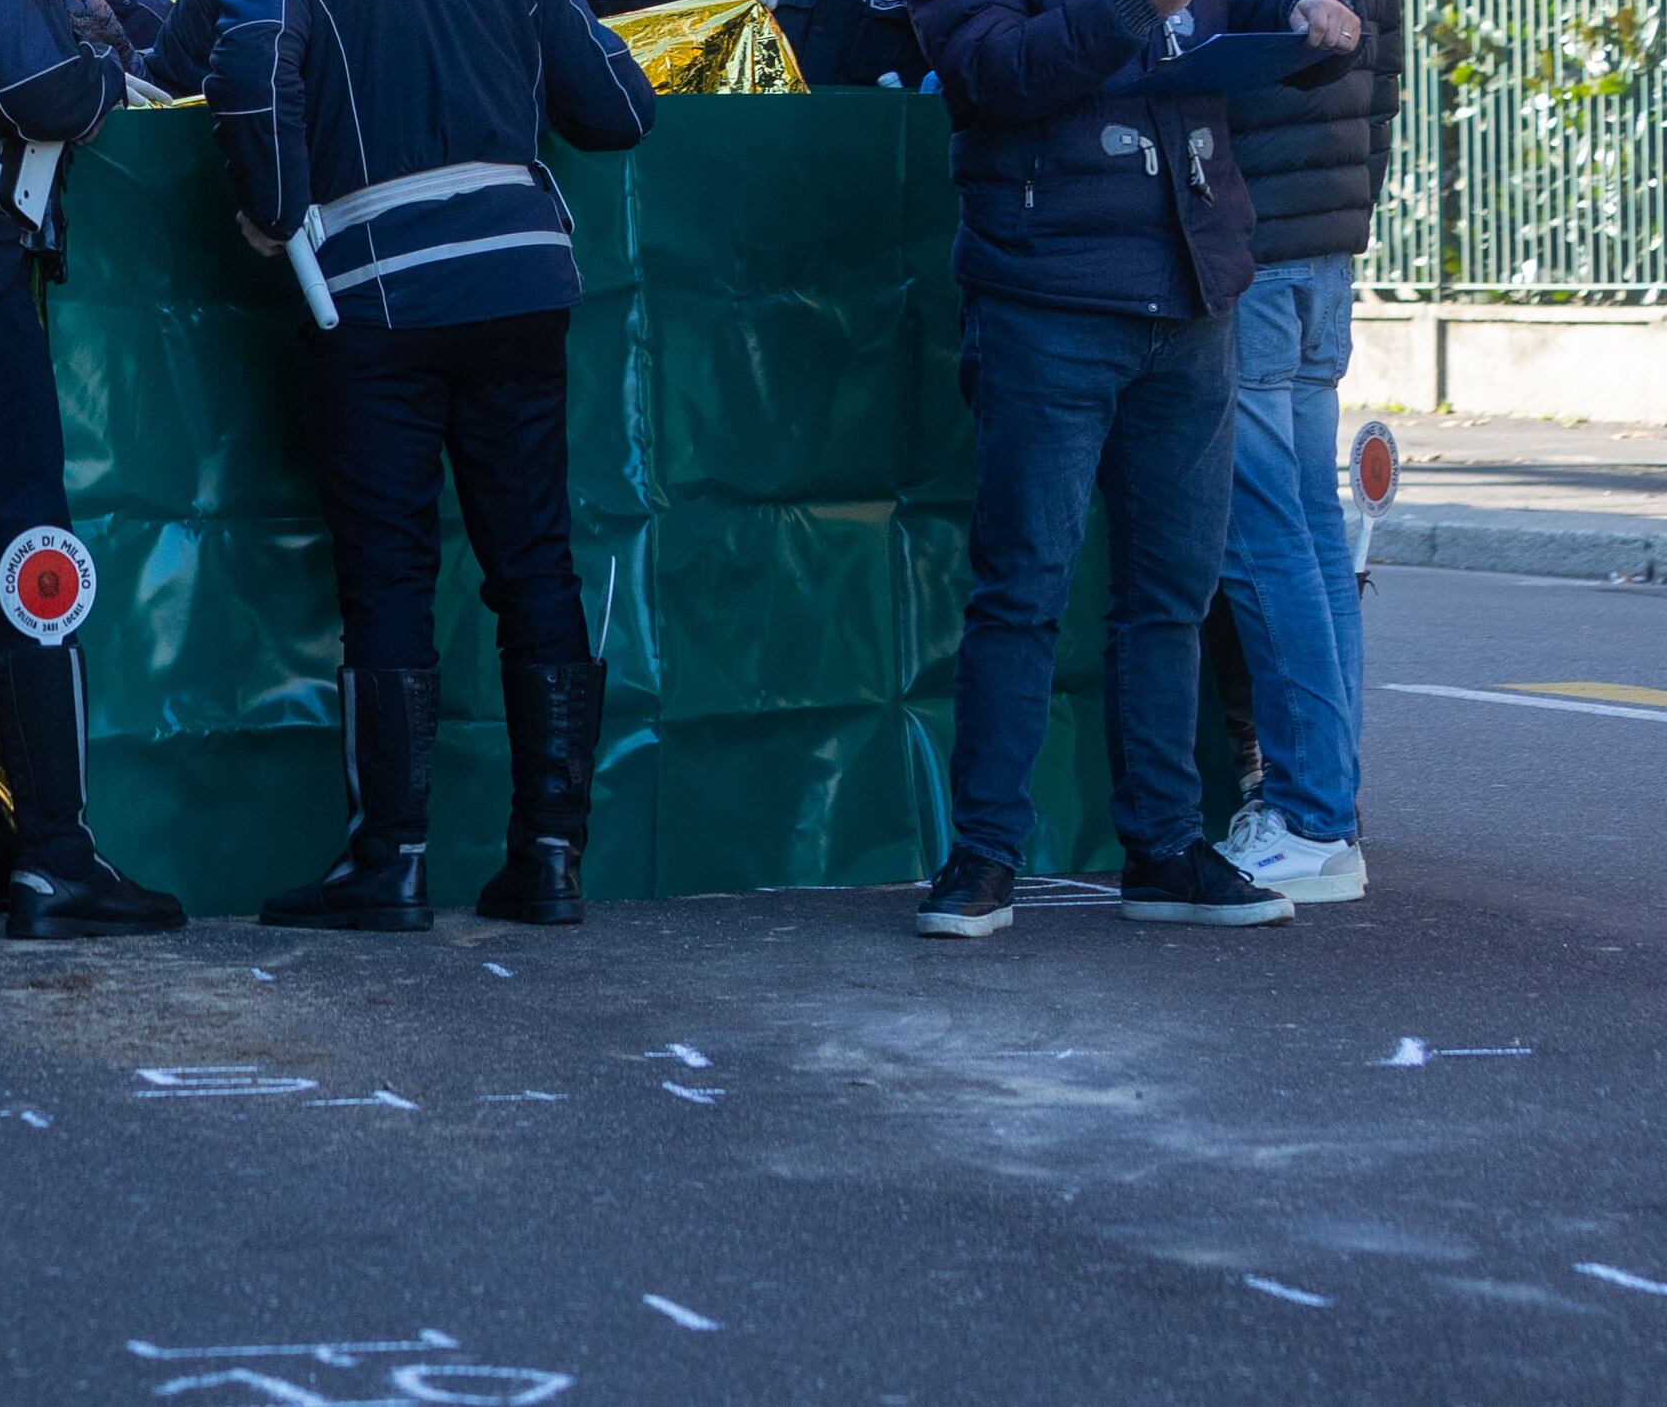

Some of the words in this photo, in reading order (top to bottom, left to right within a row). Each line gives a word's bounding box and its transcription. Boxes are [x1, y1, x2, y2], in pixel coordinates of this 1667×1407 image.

[5, 539, 36, 595] COMUNE
[41, 535, 55, 548] DI
[60, 539, 92, 590] MILANO
[13, 606, 38, 630] POLIZIA
[62, 603, 85, 628] LOCALE
